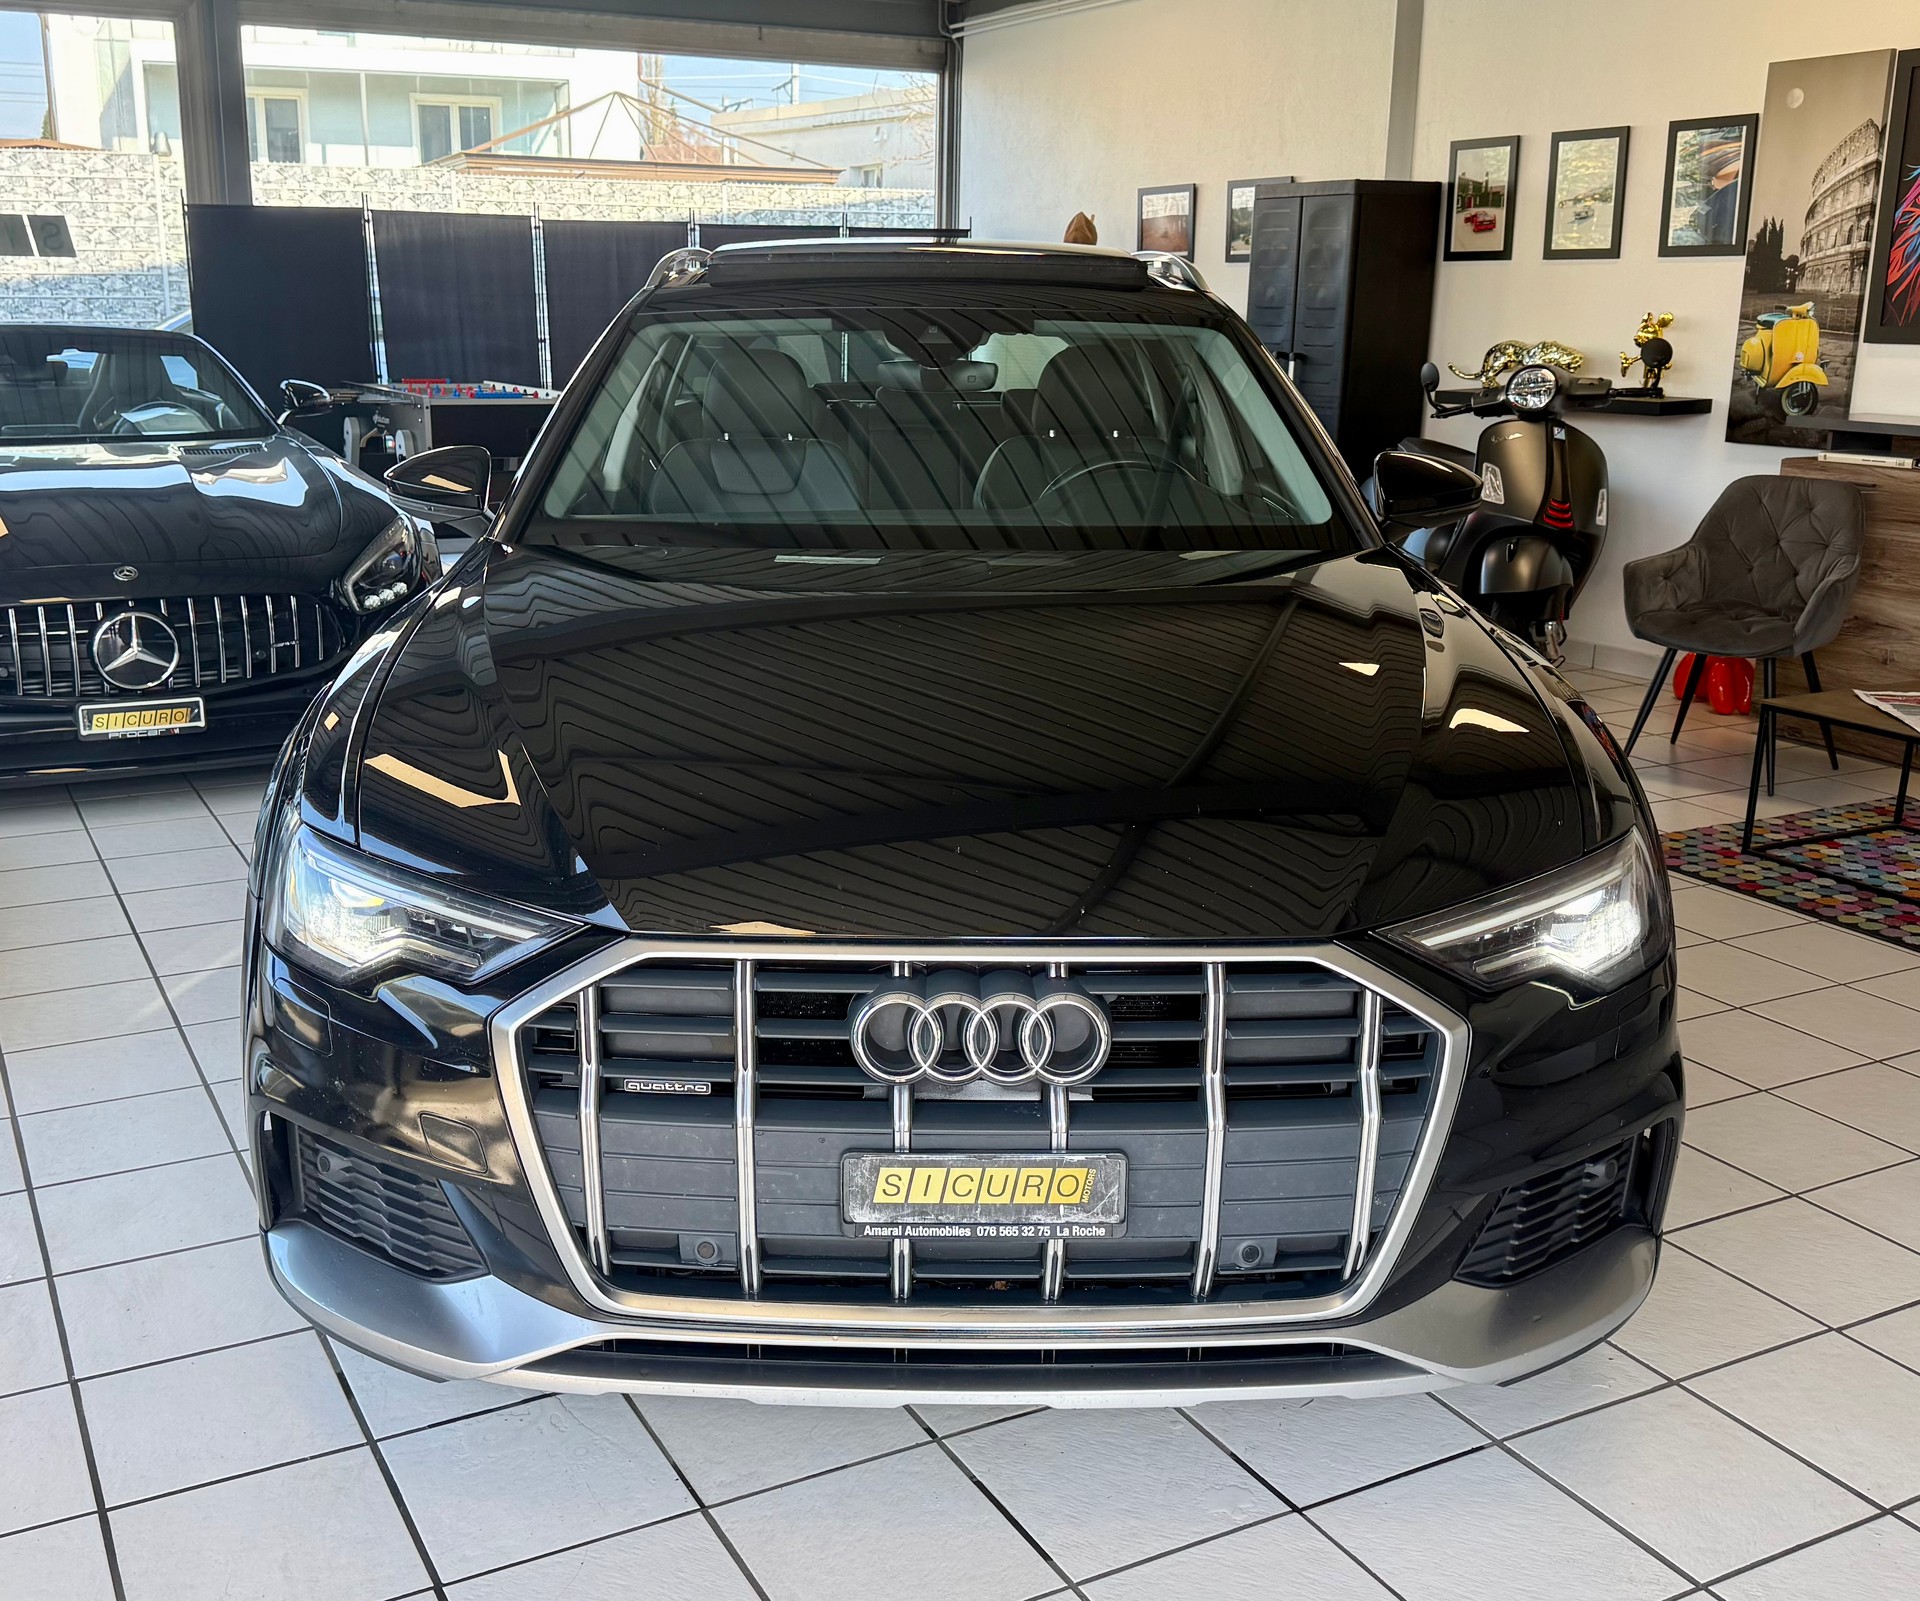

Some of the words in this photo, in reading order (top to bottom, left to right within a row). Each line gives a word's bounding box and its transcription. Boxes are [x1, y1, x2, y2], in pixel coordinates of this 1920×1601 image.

[95, 710, 185, 728] SICURO
[627, 1082, 707, 1092] quattro
[881, 1174, 1080, 1198] SICURO
[1081, 1168, 1097, 1204] MOTORS
[863, 1225, 902, 1236] Amaral
[904, 1225, 972, 1237] Automobiles
[976, 1226, 997, 1237] 076
[999, 1226, 1019, 1237] 565
[1021, 1226, 1035, 1237] 32
[1037, 1226, 1051, 1237] 75
[1056, 1226, 1070, 1237] La
[1072, 1226, 1106, 1237] Roche
